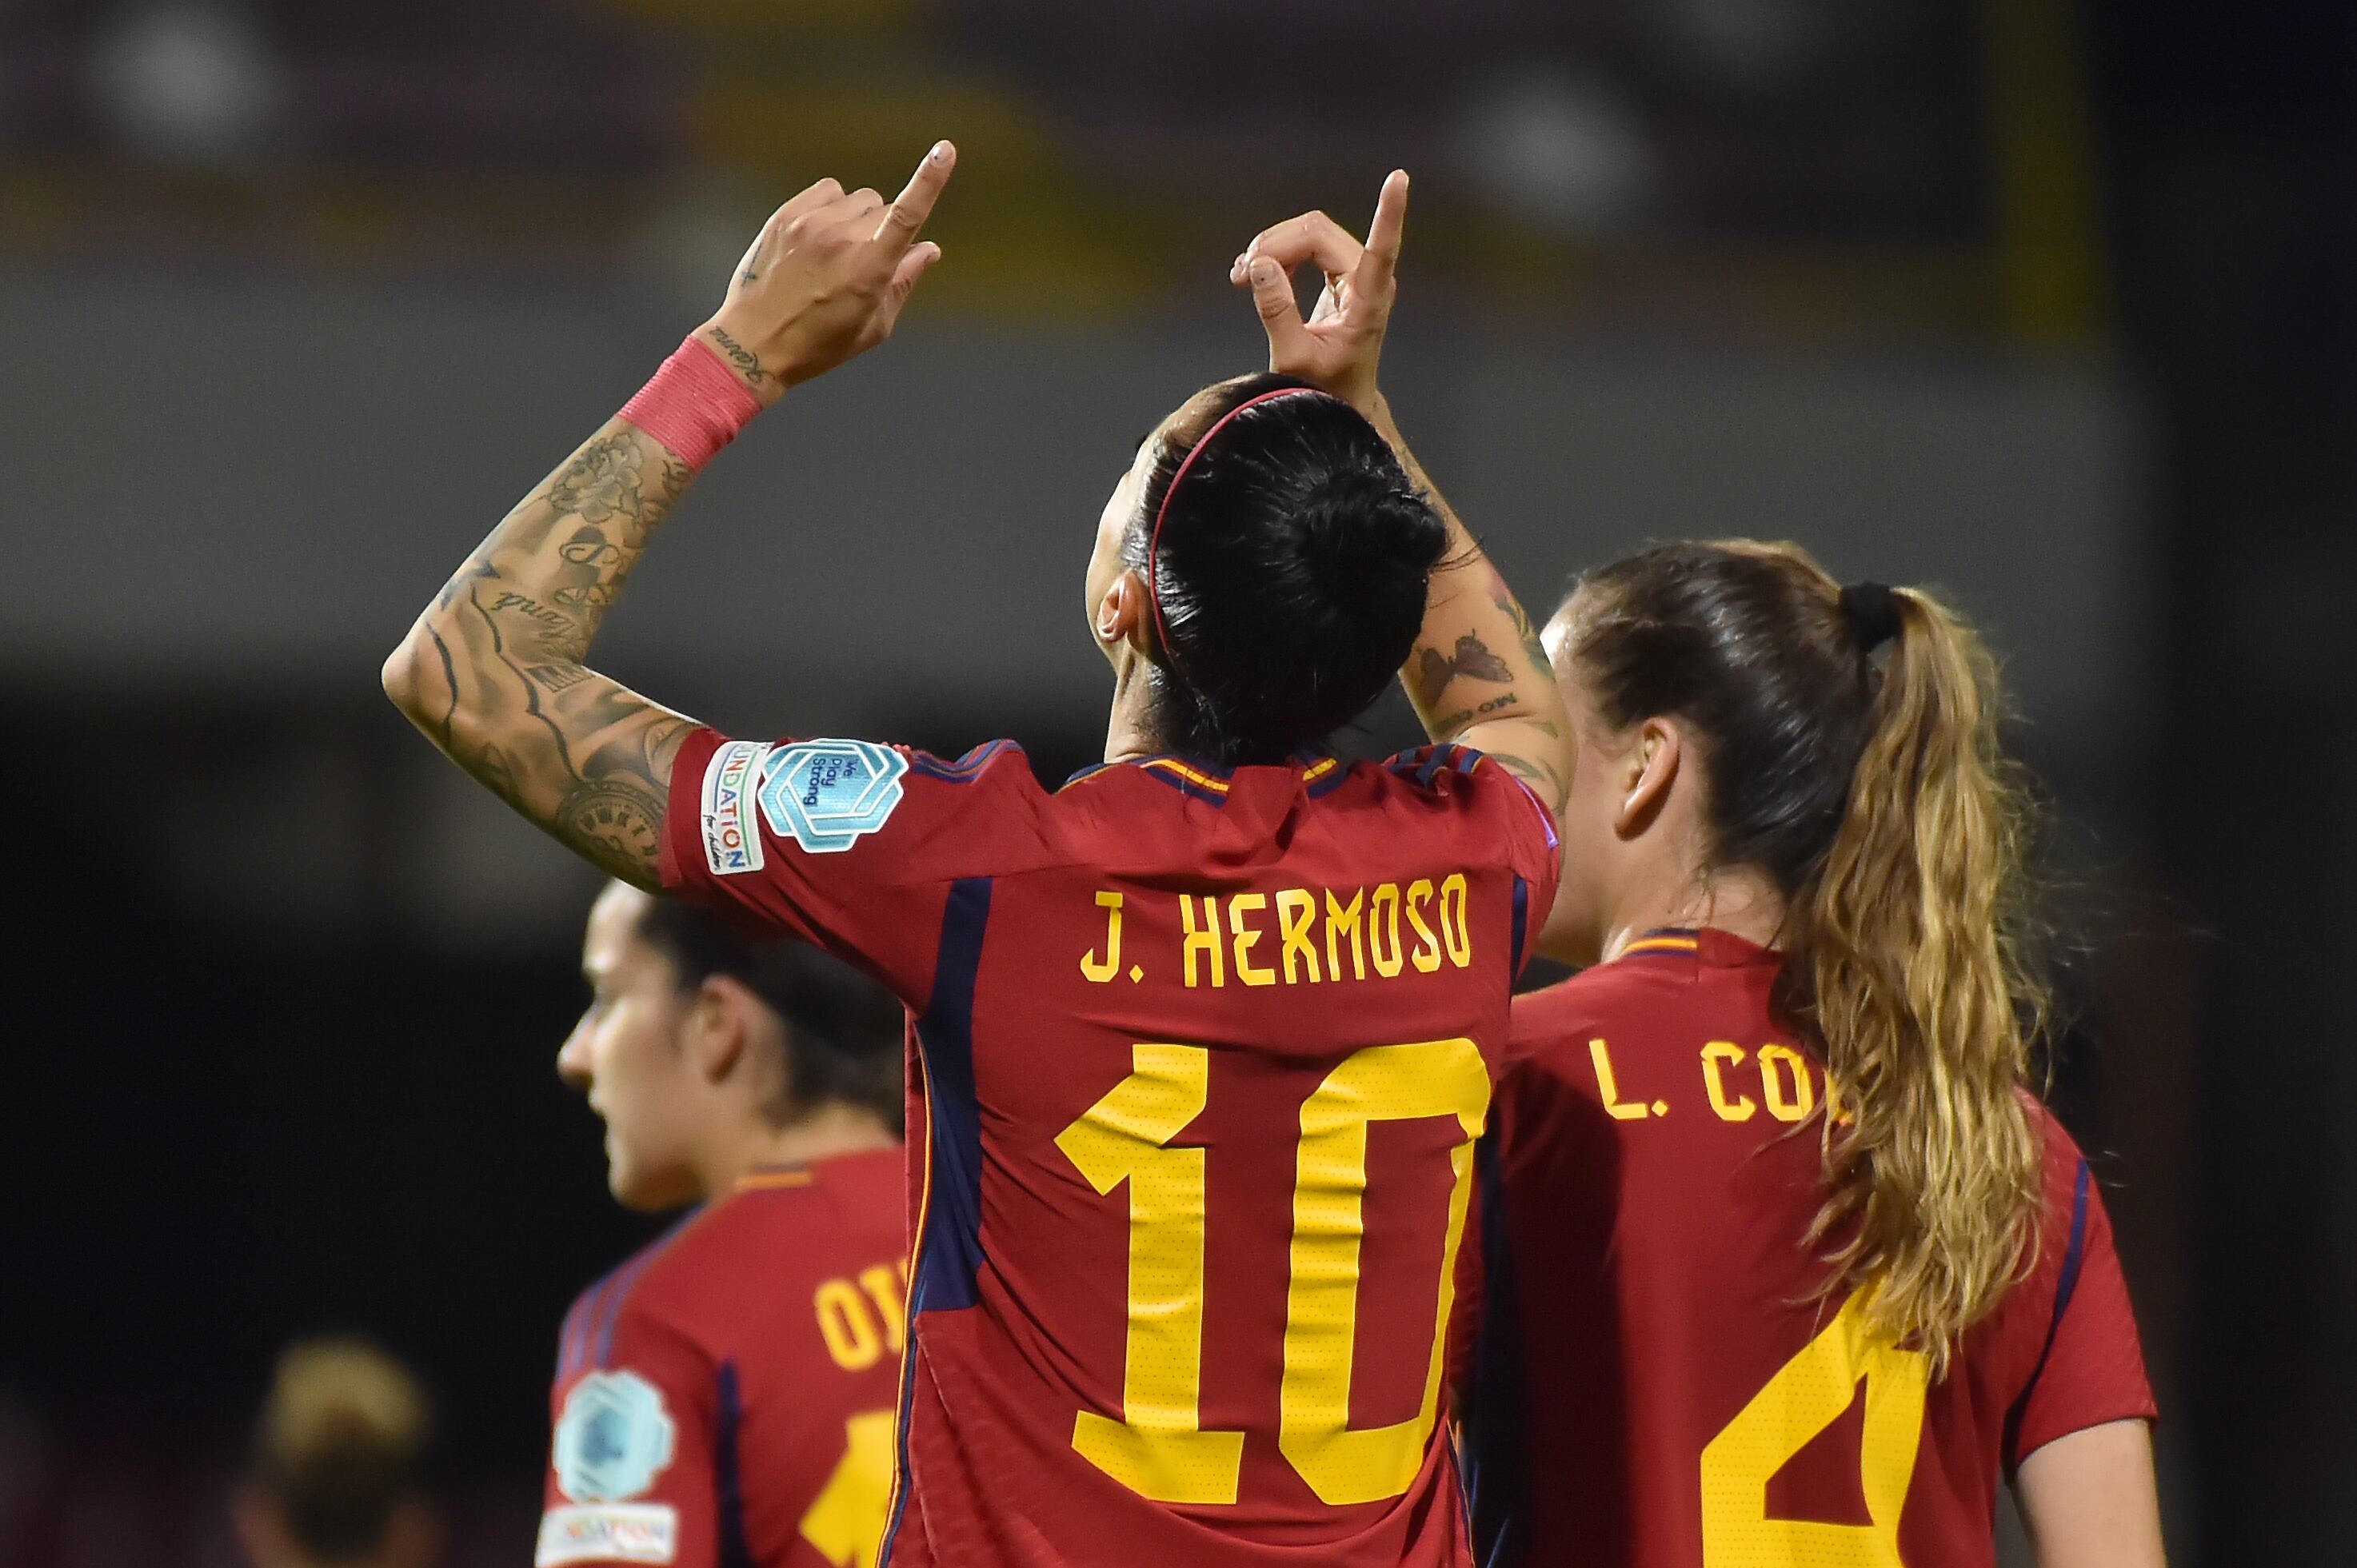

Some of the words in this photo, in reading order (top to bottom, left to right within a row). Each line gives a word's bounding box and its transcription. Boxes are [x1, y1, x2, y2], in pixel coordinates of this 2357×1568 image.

[803, 758, 826, 805] Strong
[821, 758, 843, 786] Play
[703, 814, 717, 830] for
[1081, 891, 1144, 983] J.
[1179, 873, 1471, 987] HERMOSO
[1589, 1039, 1668, 1119] L.
[1701, 1041, 1844, 1121] CO
[1053, 1037, 1490, 1506] 10
[1700, 1273, 1929, 1568] 4
